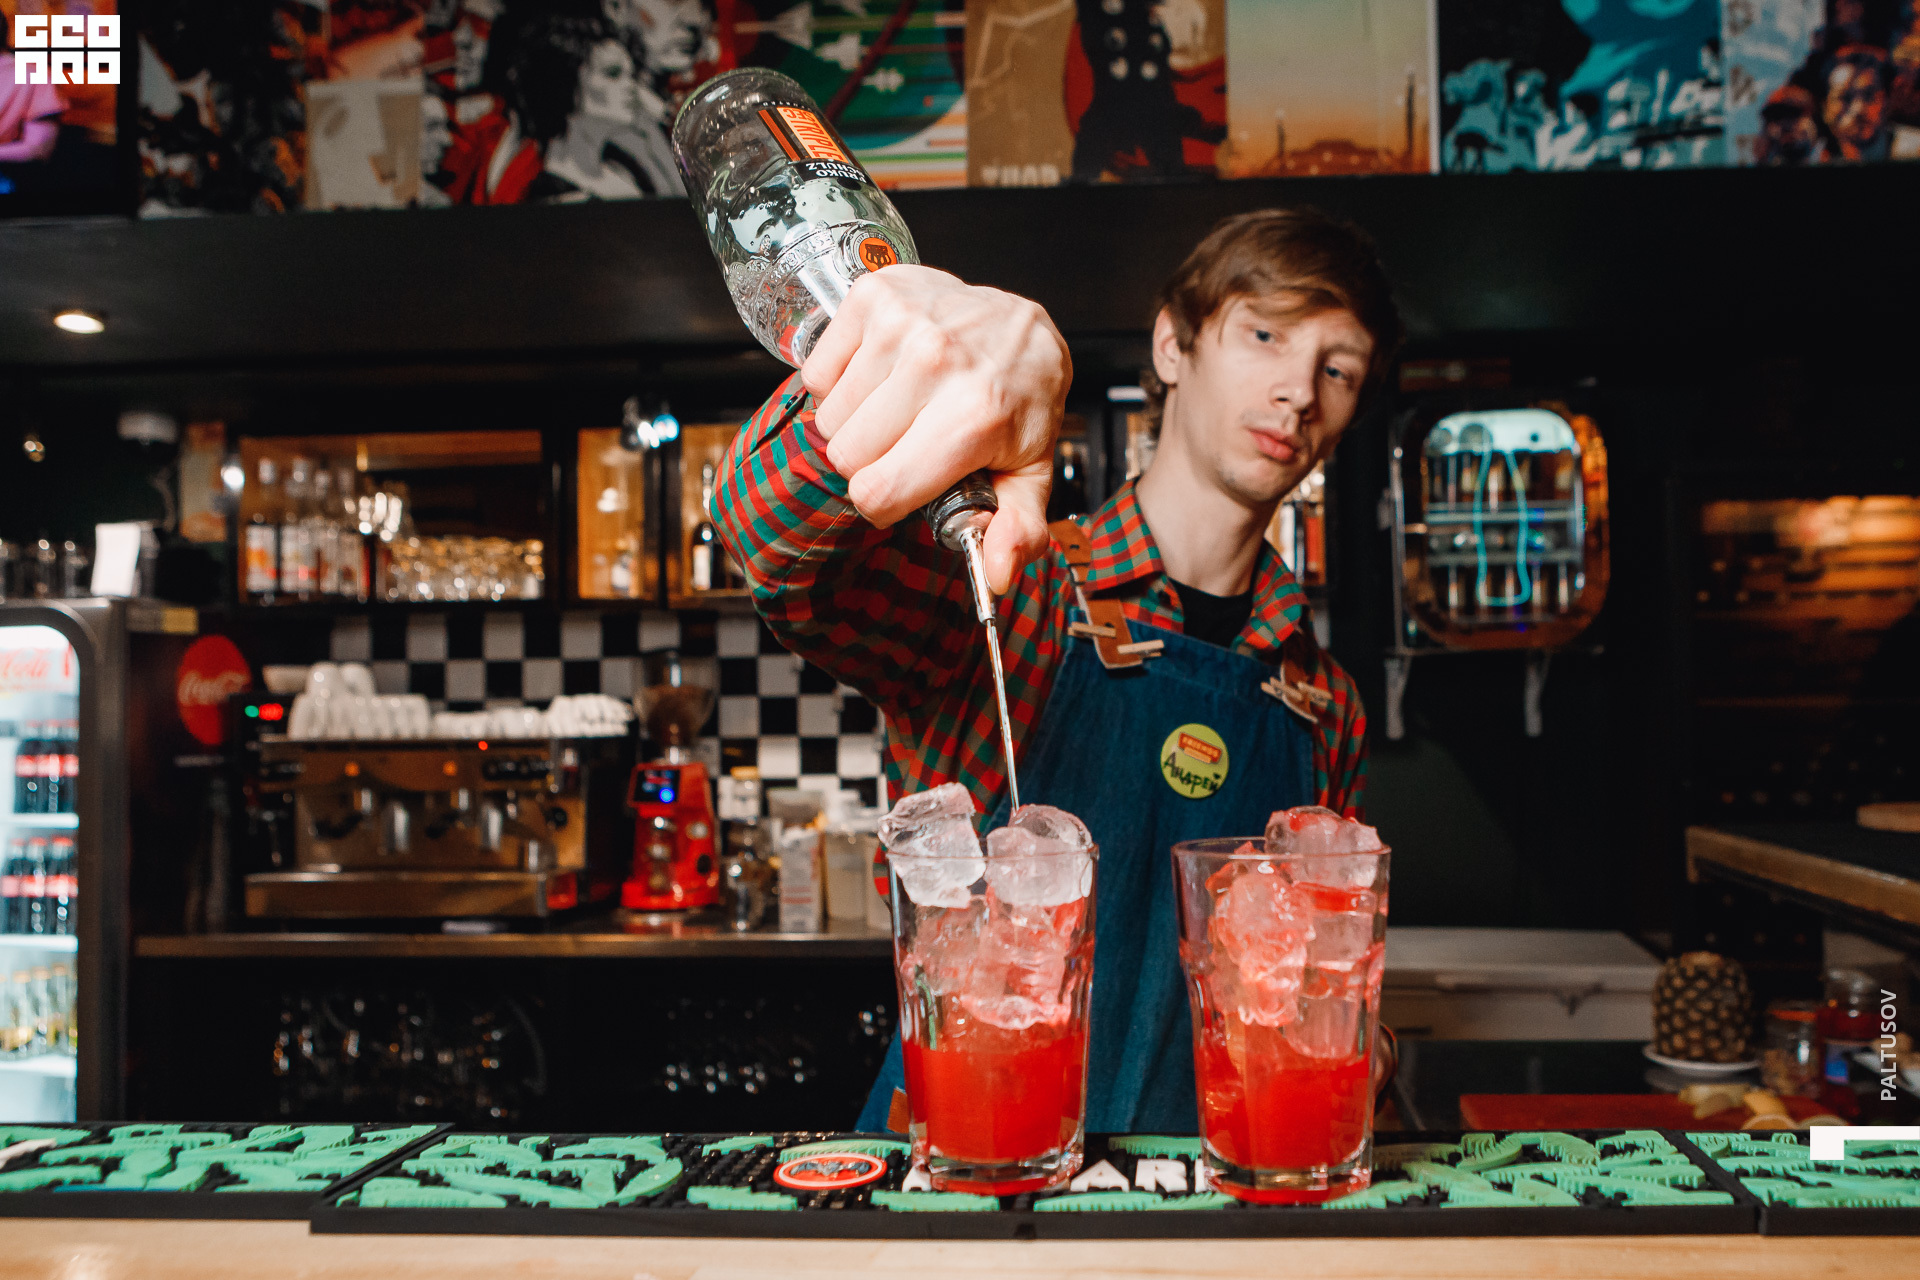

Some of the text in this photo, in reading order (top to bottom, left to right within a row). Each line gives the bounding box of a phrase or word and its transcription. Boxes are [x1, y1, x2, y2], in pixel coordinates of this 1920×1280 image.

[782, 108, 816, 121] SEC
[790, 117, 845, 161] TRIPLE
[805, 161, 866, 178] SCHULZ
[815, 168, 868, 184] FRUKO
